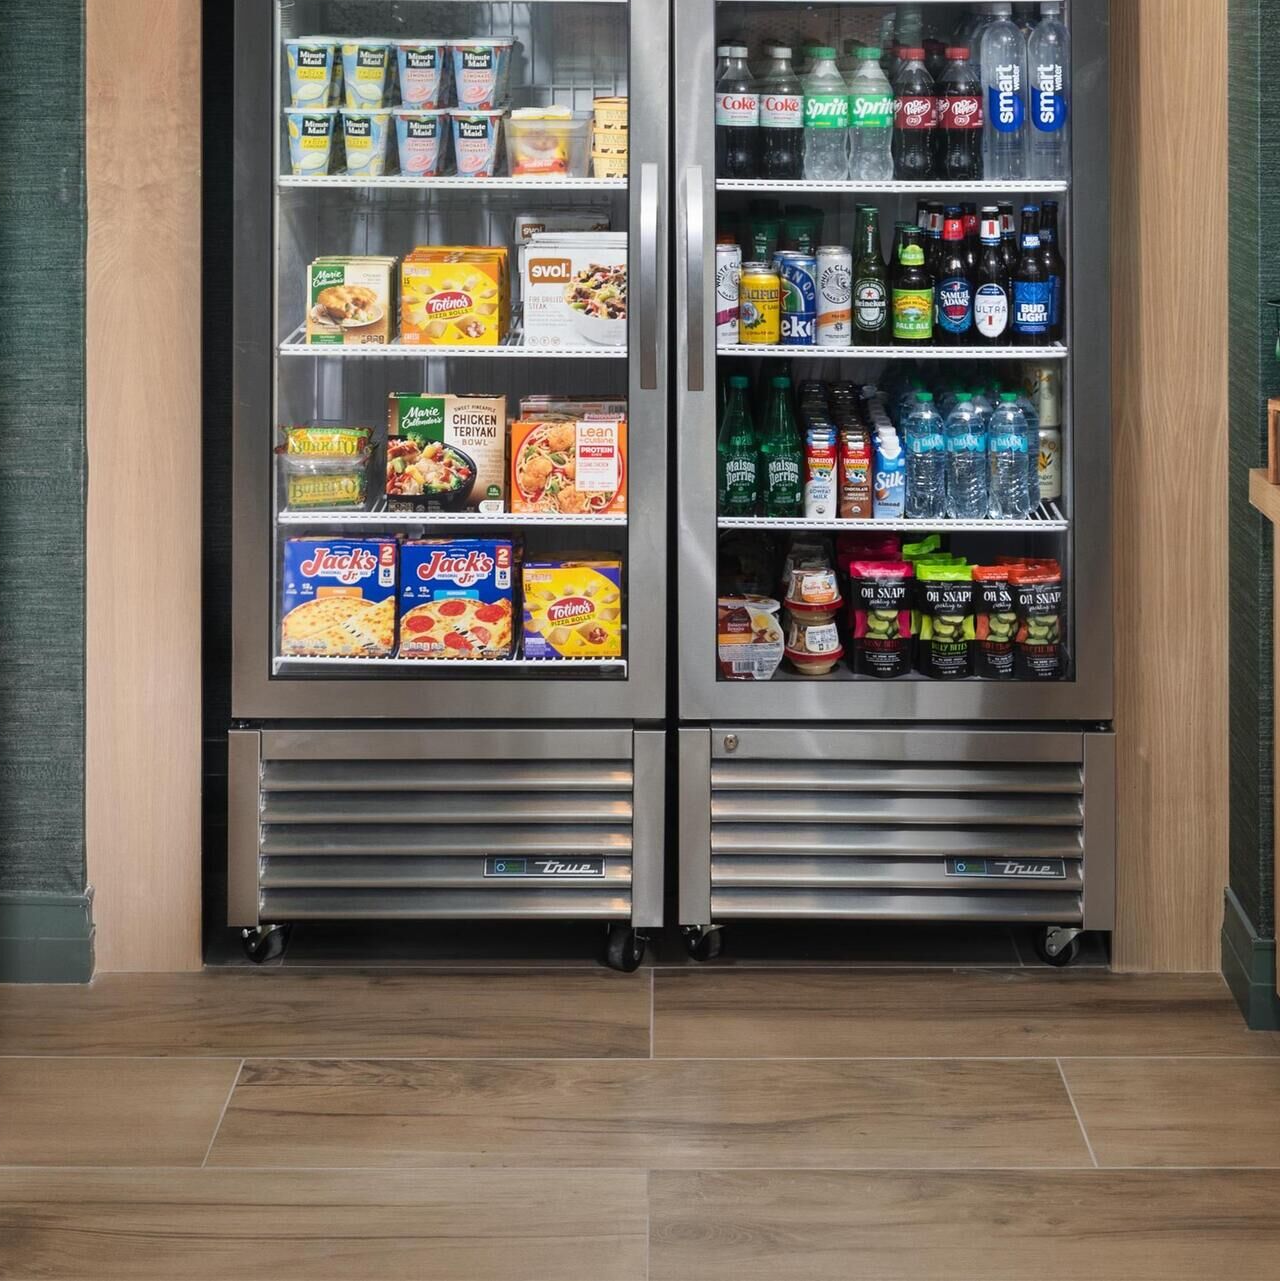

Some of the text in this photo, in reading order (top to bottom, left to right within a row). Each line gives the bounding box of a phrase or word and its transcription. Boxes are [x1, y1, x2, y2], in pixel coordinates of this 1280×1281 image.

[300, 51, 325, 59] Minute
[360, 51, 384, 59] Minute
[408, 53, 434, 61] Minute
[464, 53, 490, 61] Minute
[302, 57, 322, 65] Maid
[362, 58, 381, 66] Maid
[411, 59, 431, 67] Maid
[468, 59, 487, 68] Maid
[1012, 64, 1020, 91] water
[1054, 64, 1063, 90] water
[997, 64, 1014, 124] smart
[1037, 64, 1054, 124] smart
[722, 95, 756, 111] Coke
[765, 96, 800, 112] Coke
[806, 98, 848, 119] Sprite
[853, 97, 894, 119] Sprite
[904, 102, 931, 116] Pepper
[952, 102, 978, 116] Pepper
[304, 120, 329, 128] Minute
[346, 120, 369, 128] Minute
[409, 122, 435, 130] Minute
[460, 122, 486, 131] Minute
[348, 127, 366, 135] Maid
[412, 128, 432, 137] Maid
[463, 128, 482, 137] Maid
[317, 271, 342, 281] Marie
[403, 277, 410, 285] 15
[820, 267, 834, 289] WHITE
[941, 289, 971, 299] SAMUEL
[428, 295, 470, 311] Totino's
[855, 299, 886, 307] Heineken
[942, 298, 969, 307] ADAMS
[1021, 304, 1045, 312] BUD
[429, 309, 469, 320] PIZZA ROLLS
[975, 305, 1007, 314] ULTRA
[1017, 312, 1048, 322] LIGHT
[896, 322, 929, 330] PALE ALE
[407, 406, 440, 420] Marie
[402, 416, 444, 429] Callender's
[452, 414, 498, 426] CHICKEN
[453, 425, 497, 438] TERIYAKI
[580, 428, 614, 438] Lean
[289, 440, 356, 456] BURRITO
[462, 438, 489, 447] BOWL
[726, 459, 756, 471] Maison
[769, 460, 799, 471] Maison
[874, 470, 905, 491] Silk
[291, 479, 357, 498] BURRITO
[382, 545, 393, 559] 2
[498, 548, 509, 560] 2
[301, 548, 378, 578] Jack's
[417, 551, 495, 581] Jack's
[342, 570, 359, 581] Jr.
[458, 574, 475, 585] Jr.
[861, 588, 906, 599] OH SNAP!
[926, 592, 972, 603] OH SNAP!
[984, 591, 996, 602] OH
[1020, 593, 1062, 605] OH SNAP!
[551, 600, 592, 618] Totino's
[551, 619, 570, 627] PIZZA
[534, 860, 598, 874] true
[994, 860, 1059, 875] true
